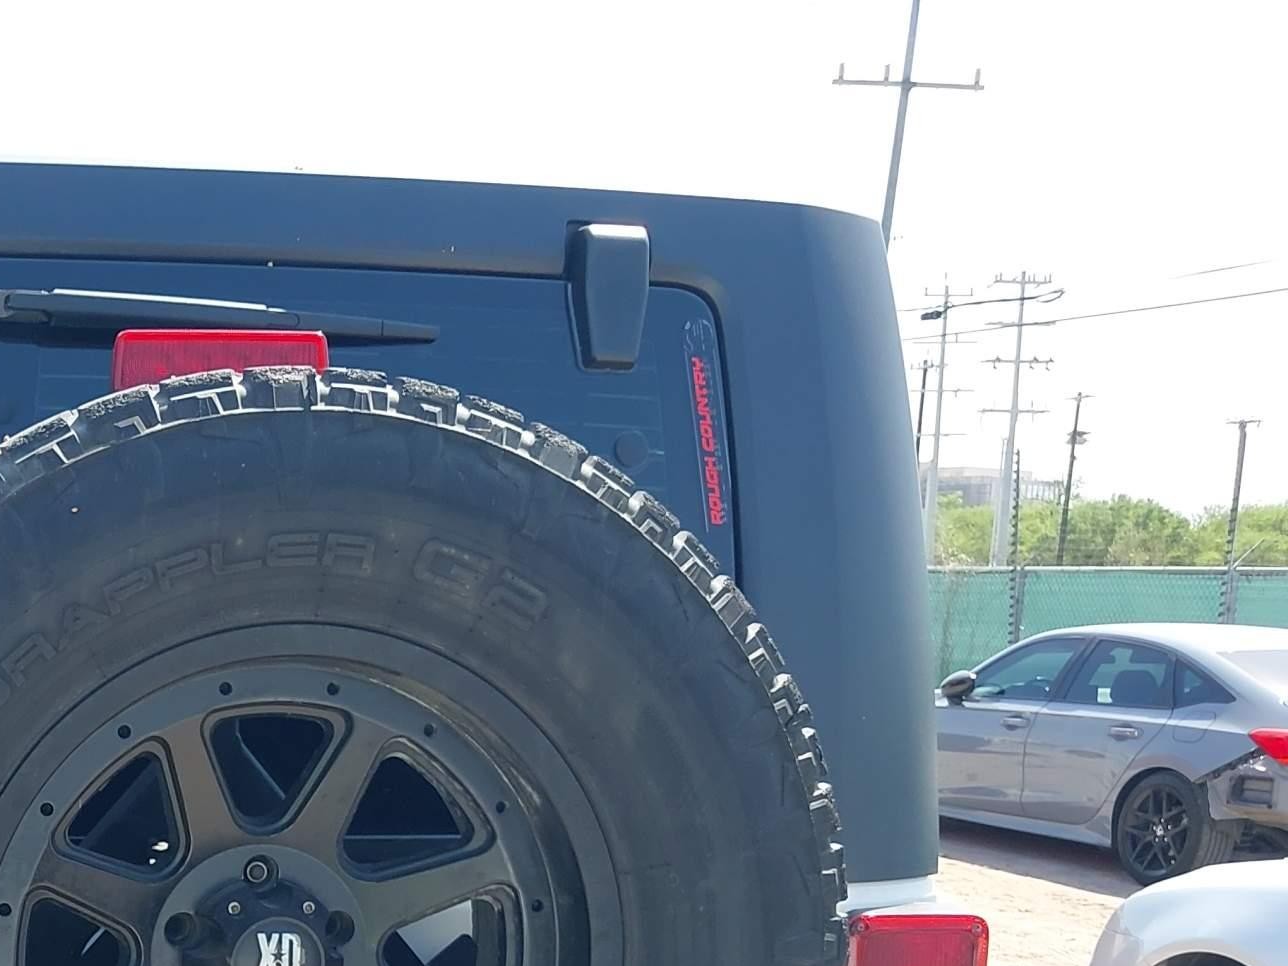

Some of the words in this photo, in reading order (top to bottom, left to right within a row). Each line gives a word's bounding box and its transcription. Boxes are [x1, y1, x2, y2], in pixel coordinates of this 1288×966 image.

[691, 358, 716, 452] COUNTRY
[704, 457, 724, 526] ROUGH
[413, 536, 549, 632] G2
